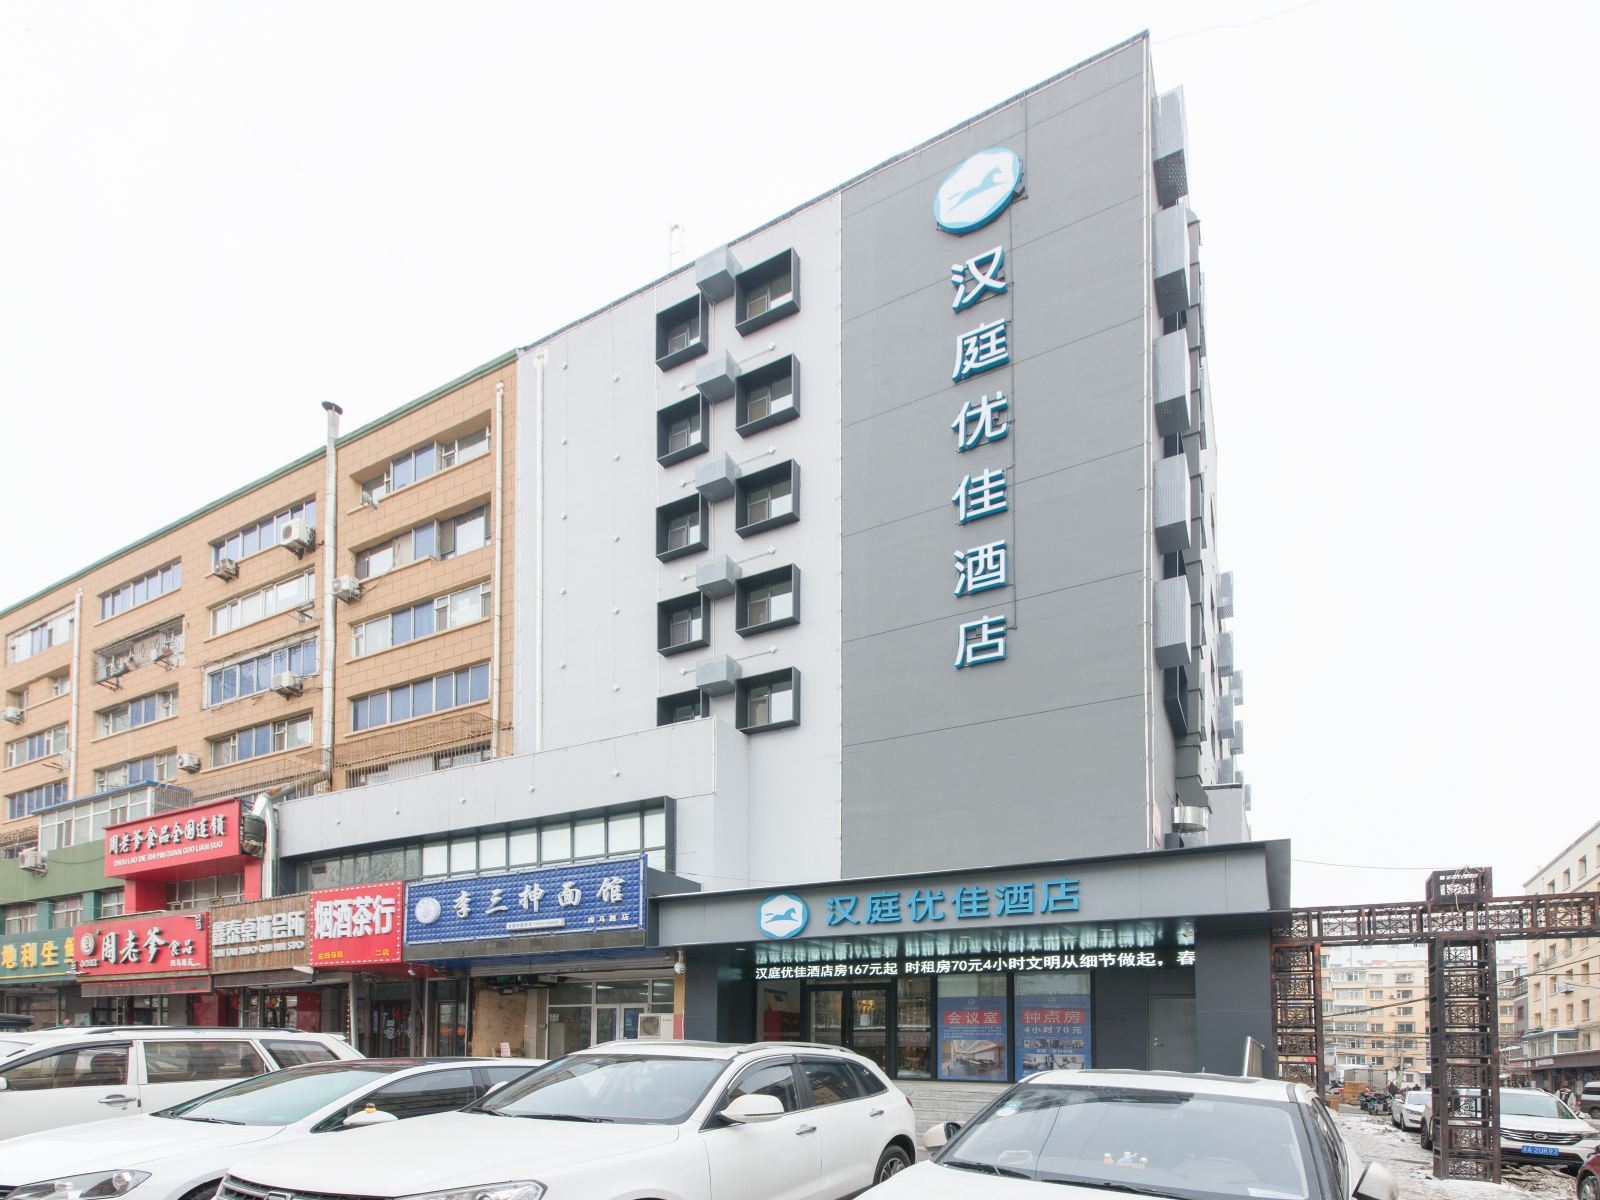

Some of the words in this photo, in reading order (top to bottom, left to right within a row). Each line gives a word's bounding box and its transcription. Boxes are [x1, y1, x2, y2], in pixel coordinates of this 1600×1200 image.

[951, 245, 1010, 670] 汉庭优佳酒店
[314, 894, 396, 939] 烟酒茶行
[827, 878, 1080, 926] 汉庭优佳酒店
[755, 962, 898, 980] 汉庭优佳酒店房167元起
[947, 1012, 999, 1025] 会议室
[1023, 1011, 1081, 1025] 钟点房
